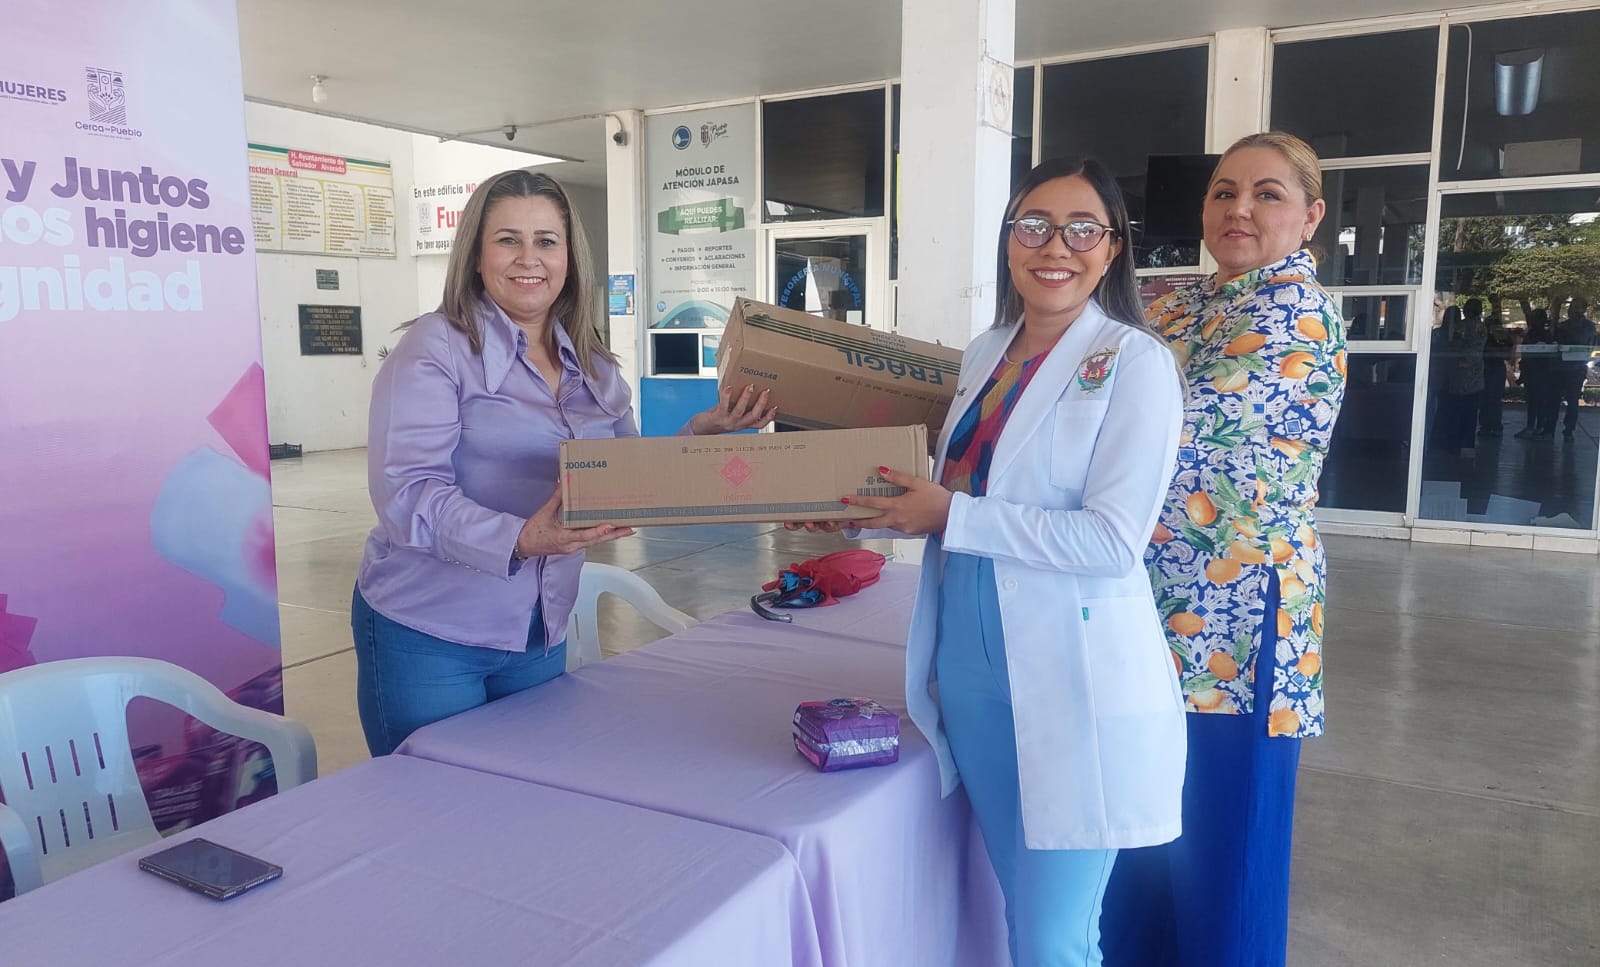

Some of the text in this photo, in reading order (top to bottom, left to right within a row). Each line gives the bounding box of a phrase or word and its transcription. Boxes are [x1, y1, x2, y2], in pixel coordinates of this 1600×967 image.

[75, 121, 104, 133] Cerca
[111, 126, 142, 137] Pueblo
[275, 168, 298, 178] General
[676, 165, 725, 177] MÓDULO DE
[1, 158, 37, 203] y
[50, 156, 210, 210] Juntos
[414, 183, 477, 198] En este edificio NO
[662, 176, 740, 191] ATENCIÓN JAPASA
[0, 204, 75, 246] os
[85, 206, 245, 258] higiene
[740, 366, 778, 381] 70004348
[837, 347, 944, 386] FRÁGIL
[564, 460, 608, 470] 70004348
